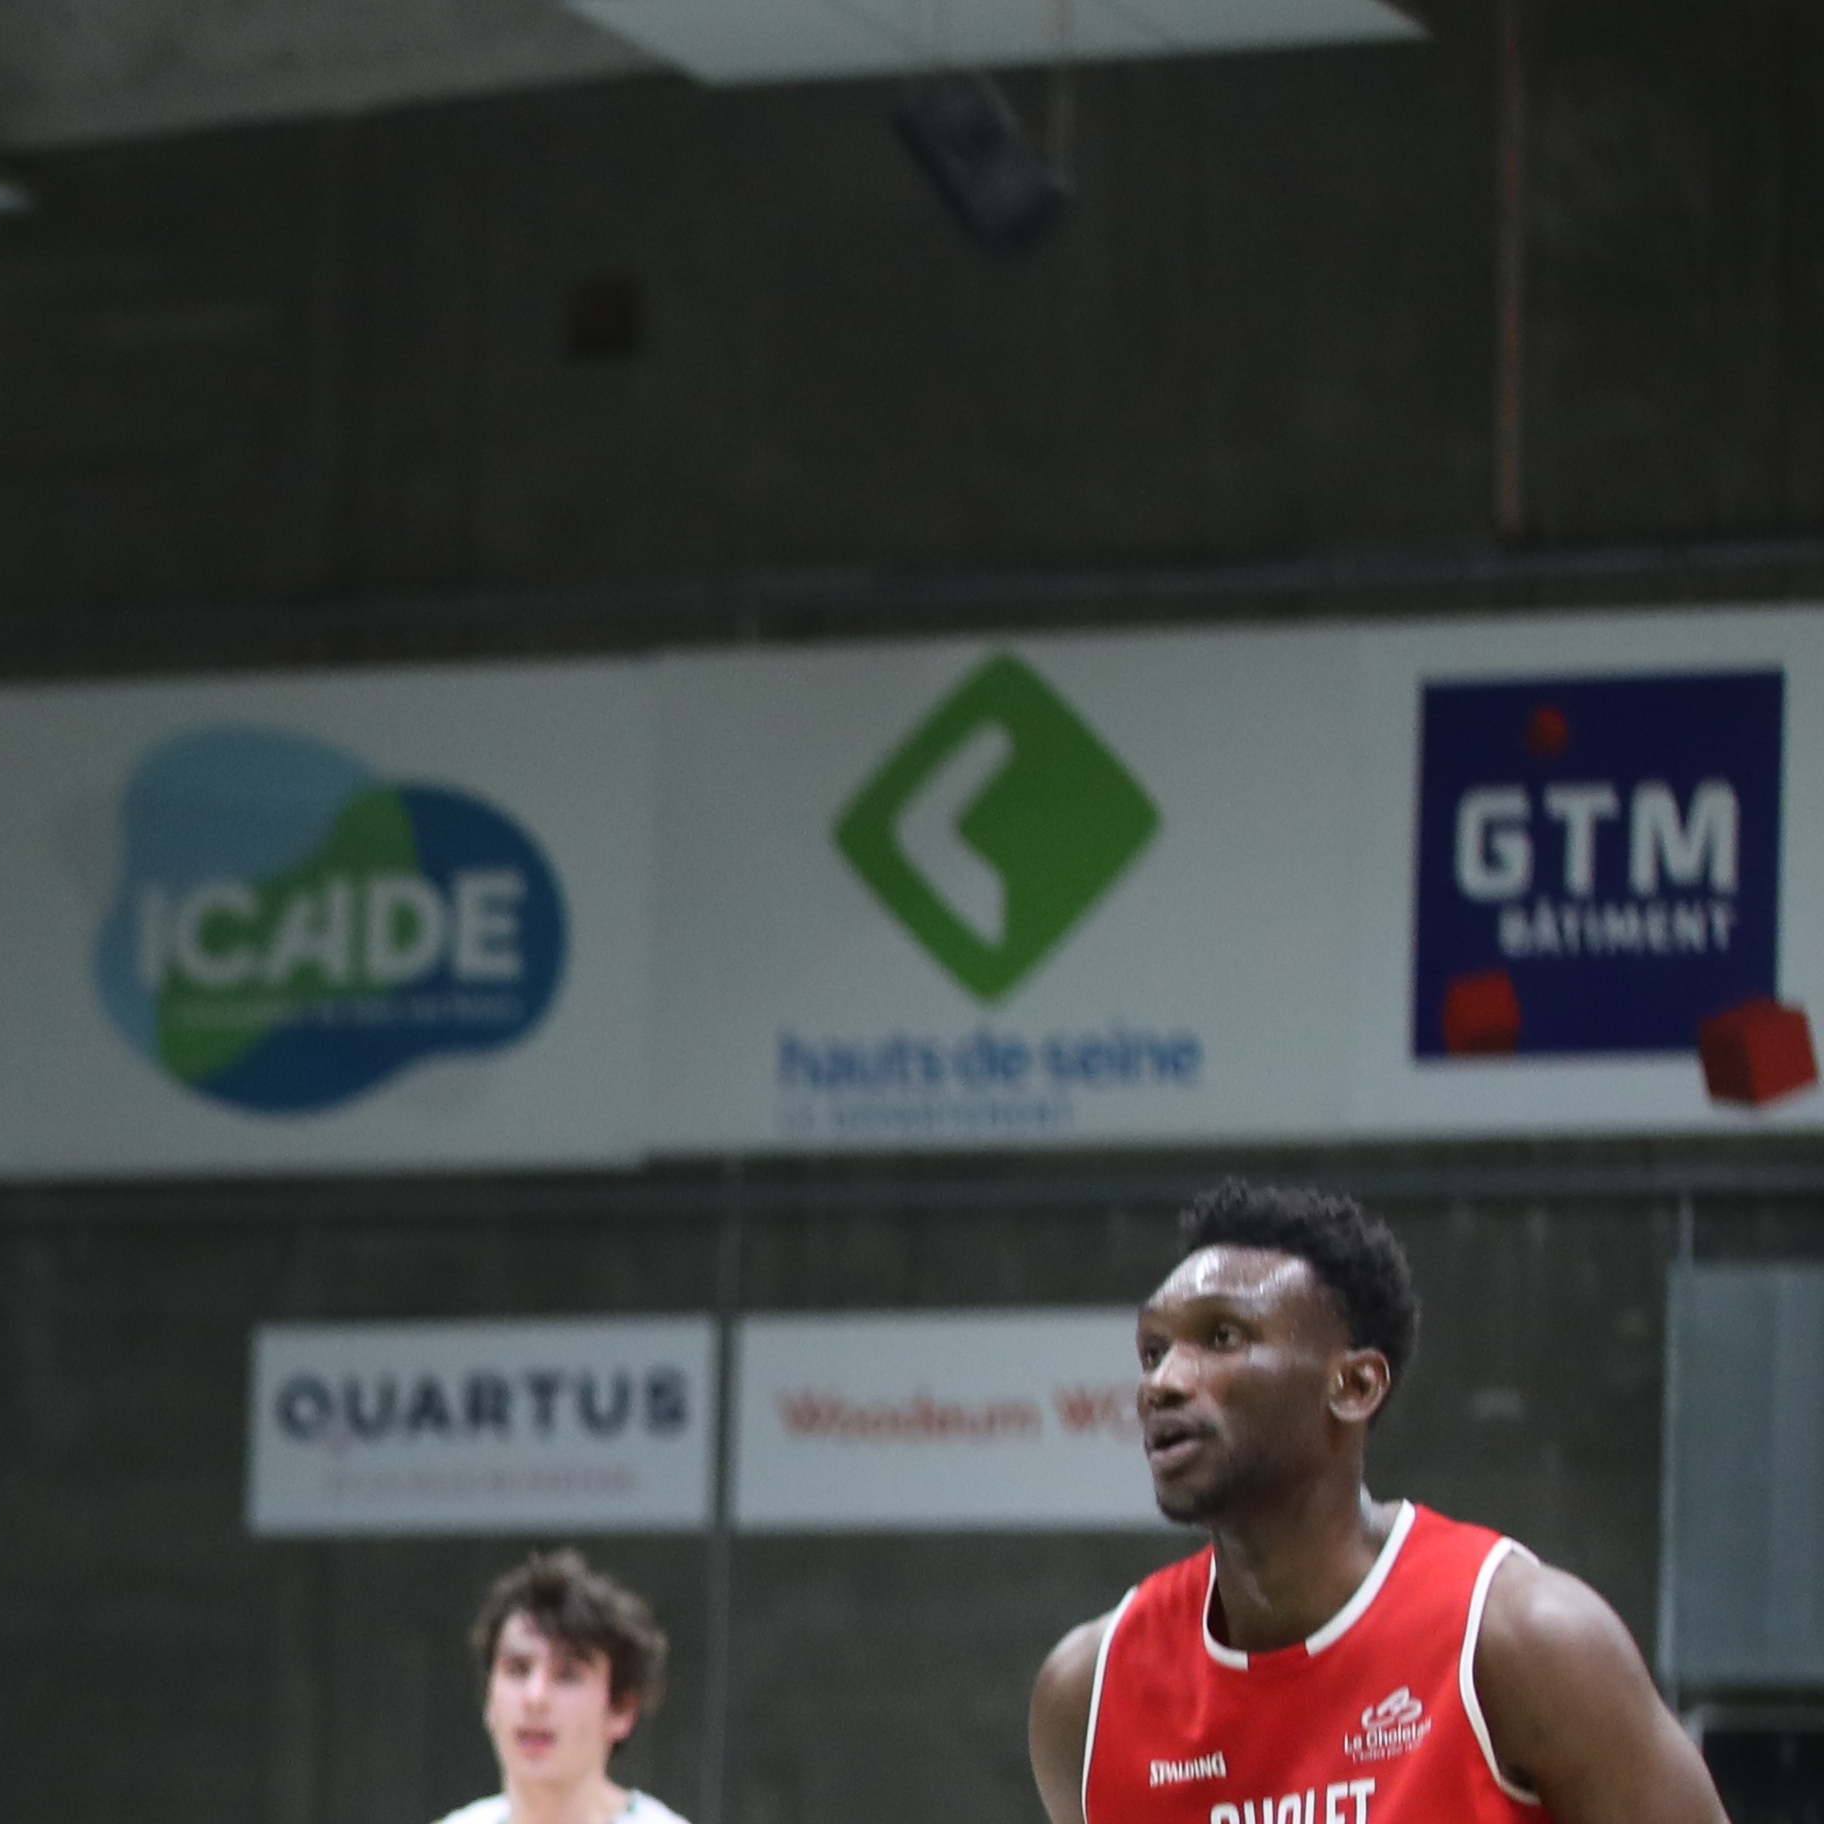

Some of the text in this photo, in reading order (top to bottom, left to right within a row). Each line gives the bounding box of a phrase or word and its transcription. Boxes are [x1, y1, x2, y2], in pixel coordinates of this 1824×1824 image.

[1454, 778, 1741, 904] GTM
[136, 868, 529, 988] ICADE
[1498, 896, 1736, 960] BÂTIMENT
[776, 1014, 1203, 1088] hauts de seine
[274, 1364, 690, 1448] QUARTUS
